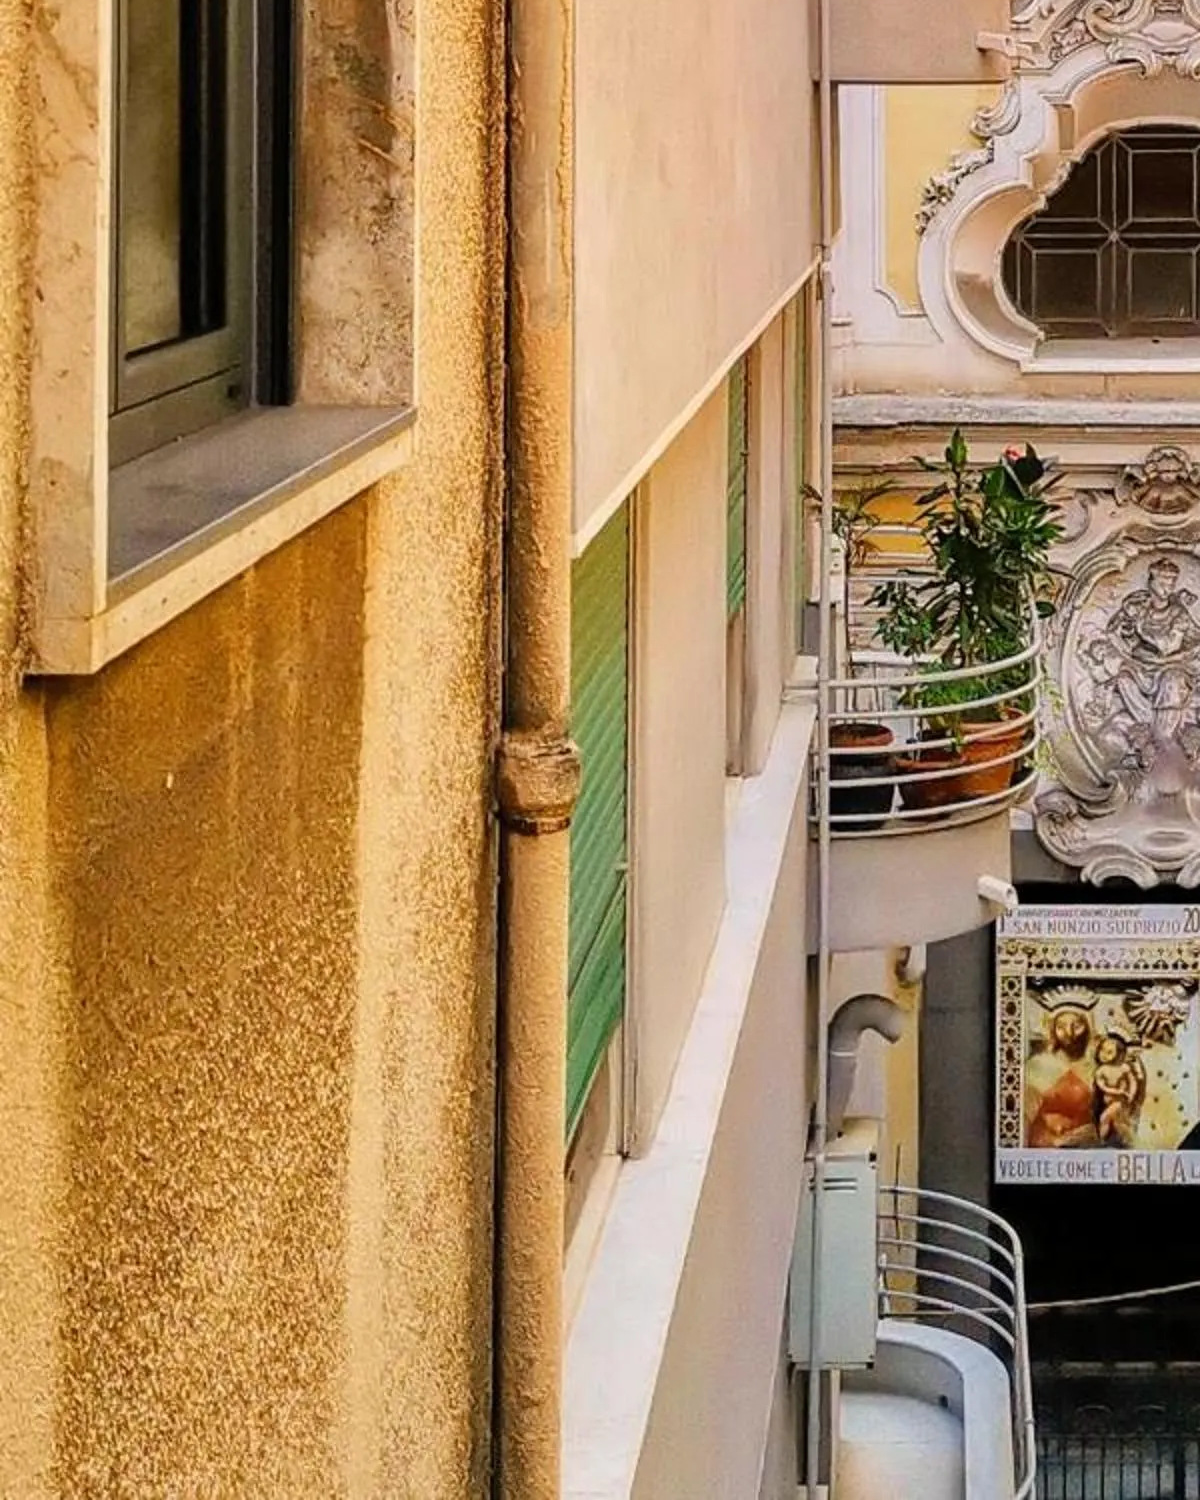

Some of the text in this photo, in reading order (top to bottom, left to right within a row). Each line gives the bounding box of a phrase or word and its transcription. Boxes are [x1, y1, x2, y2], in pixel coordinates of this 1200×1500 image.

[1013, 919, 1041, 934] SAN
[1047, 919, 1100, 934] NUNZIO
[1057, 1158, 1094, 1178] COME
[1117, 1152, 1187, 1183] BELLA
